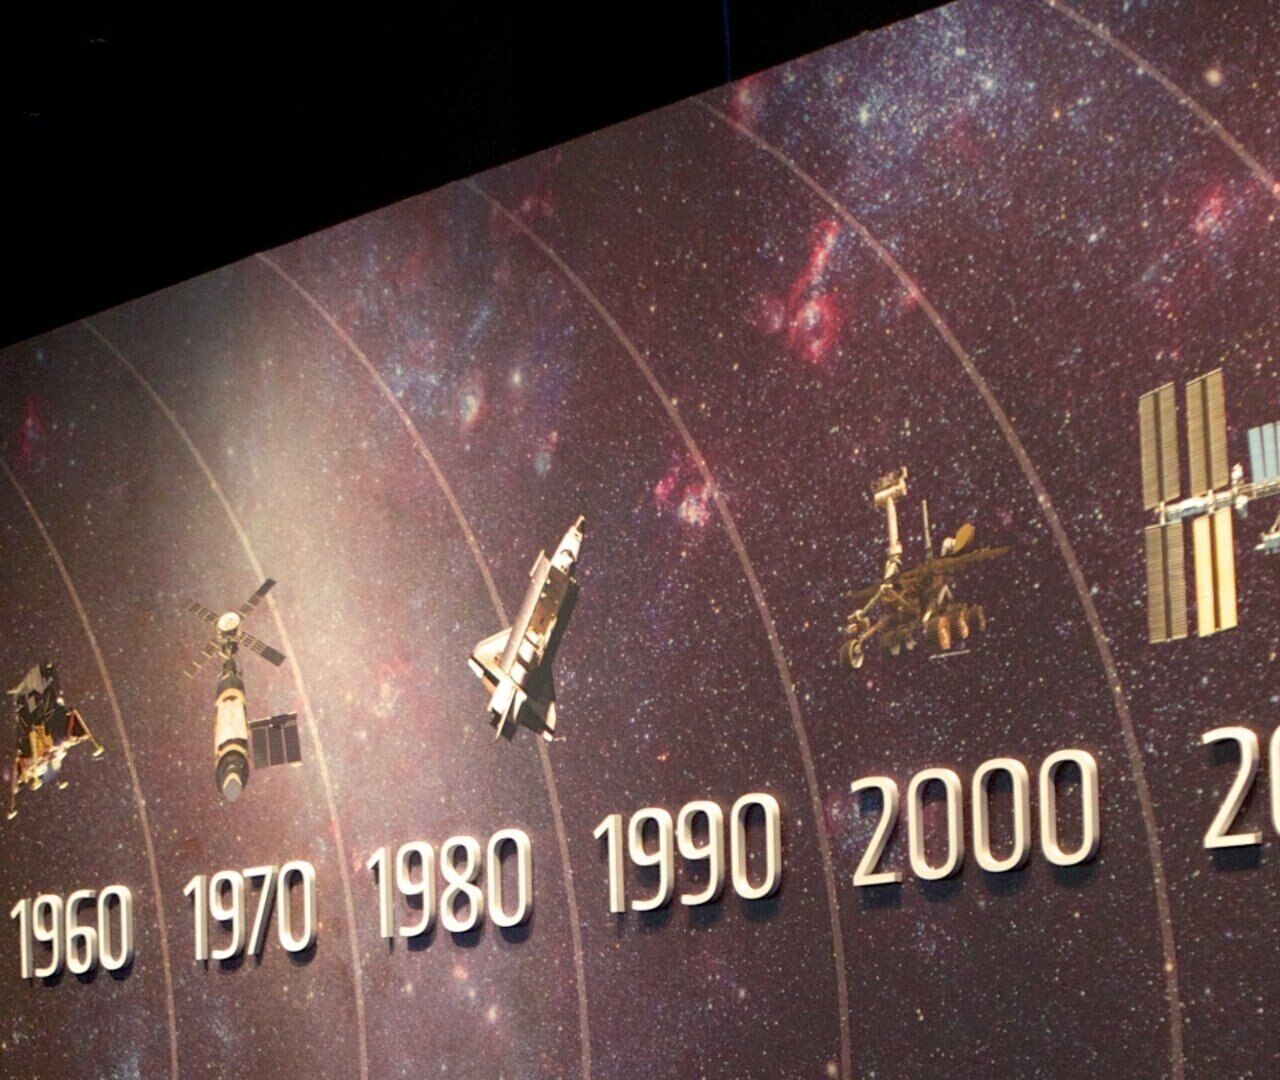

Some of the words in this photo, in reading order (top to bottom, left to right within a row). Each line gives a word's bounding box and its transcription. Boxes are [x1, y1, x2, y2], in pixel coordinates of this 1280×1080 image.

[594, 791, 783, 914] 1990
[853, 749, 1101, 888] 2000
[11, 884, 134, 980] 1960
[183, 860, 318, 962] 1970
[366, 829, 532, 942] 1980
